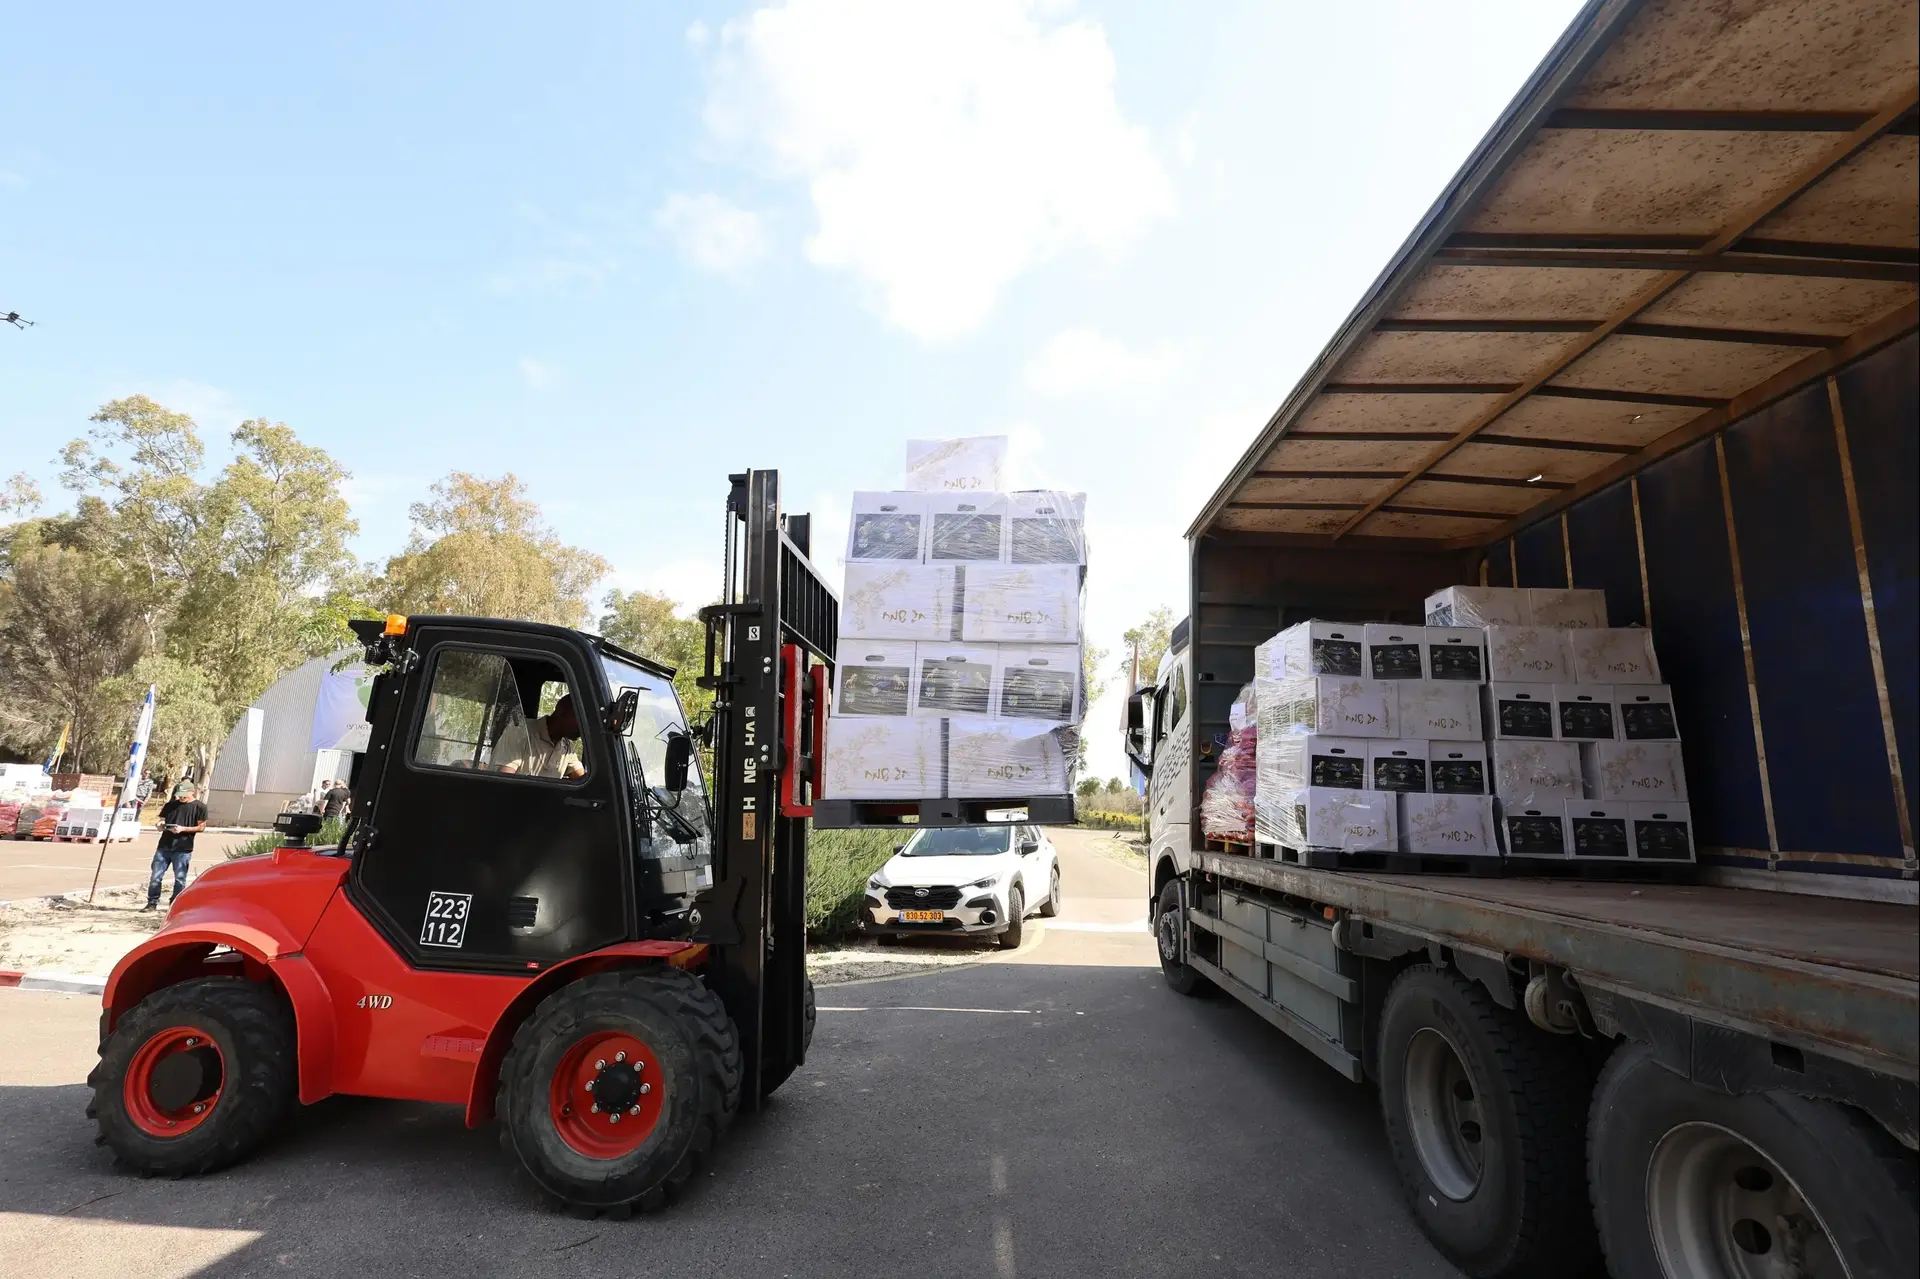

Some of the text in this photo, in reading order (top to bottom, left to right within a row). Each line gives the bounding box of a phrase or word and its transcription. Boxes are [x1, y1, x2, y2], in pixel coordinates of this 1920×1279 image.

[429, 897, 468, 920] 223
[427, 921, 461, 944] 112
[356, 995, 393, 1009] 4WD
